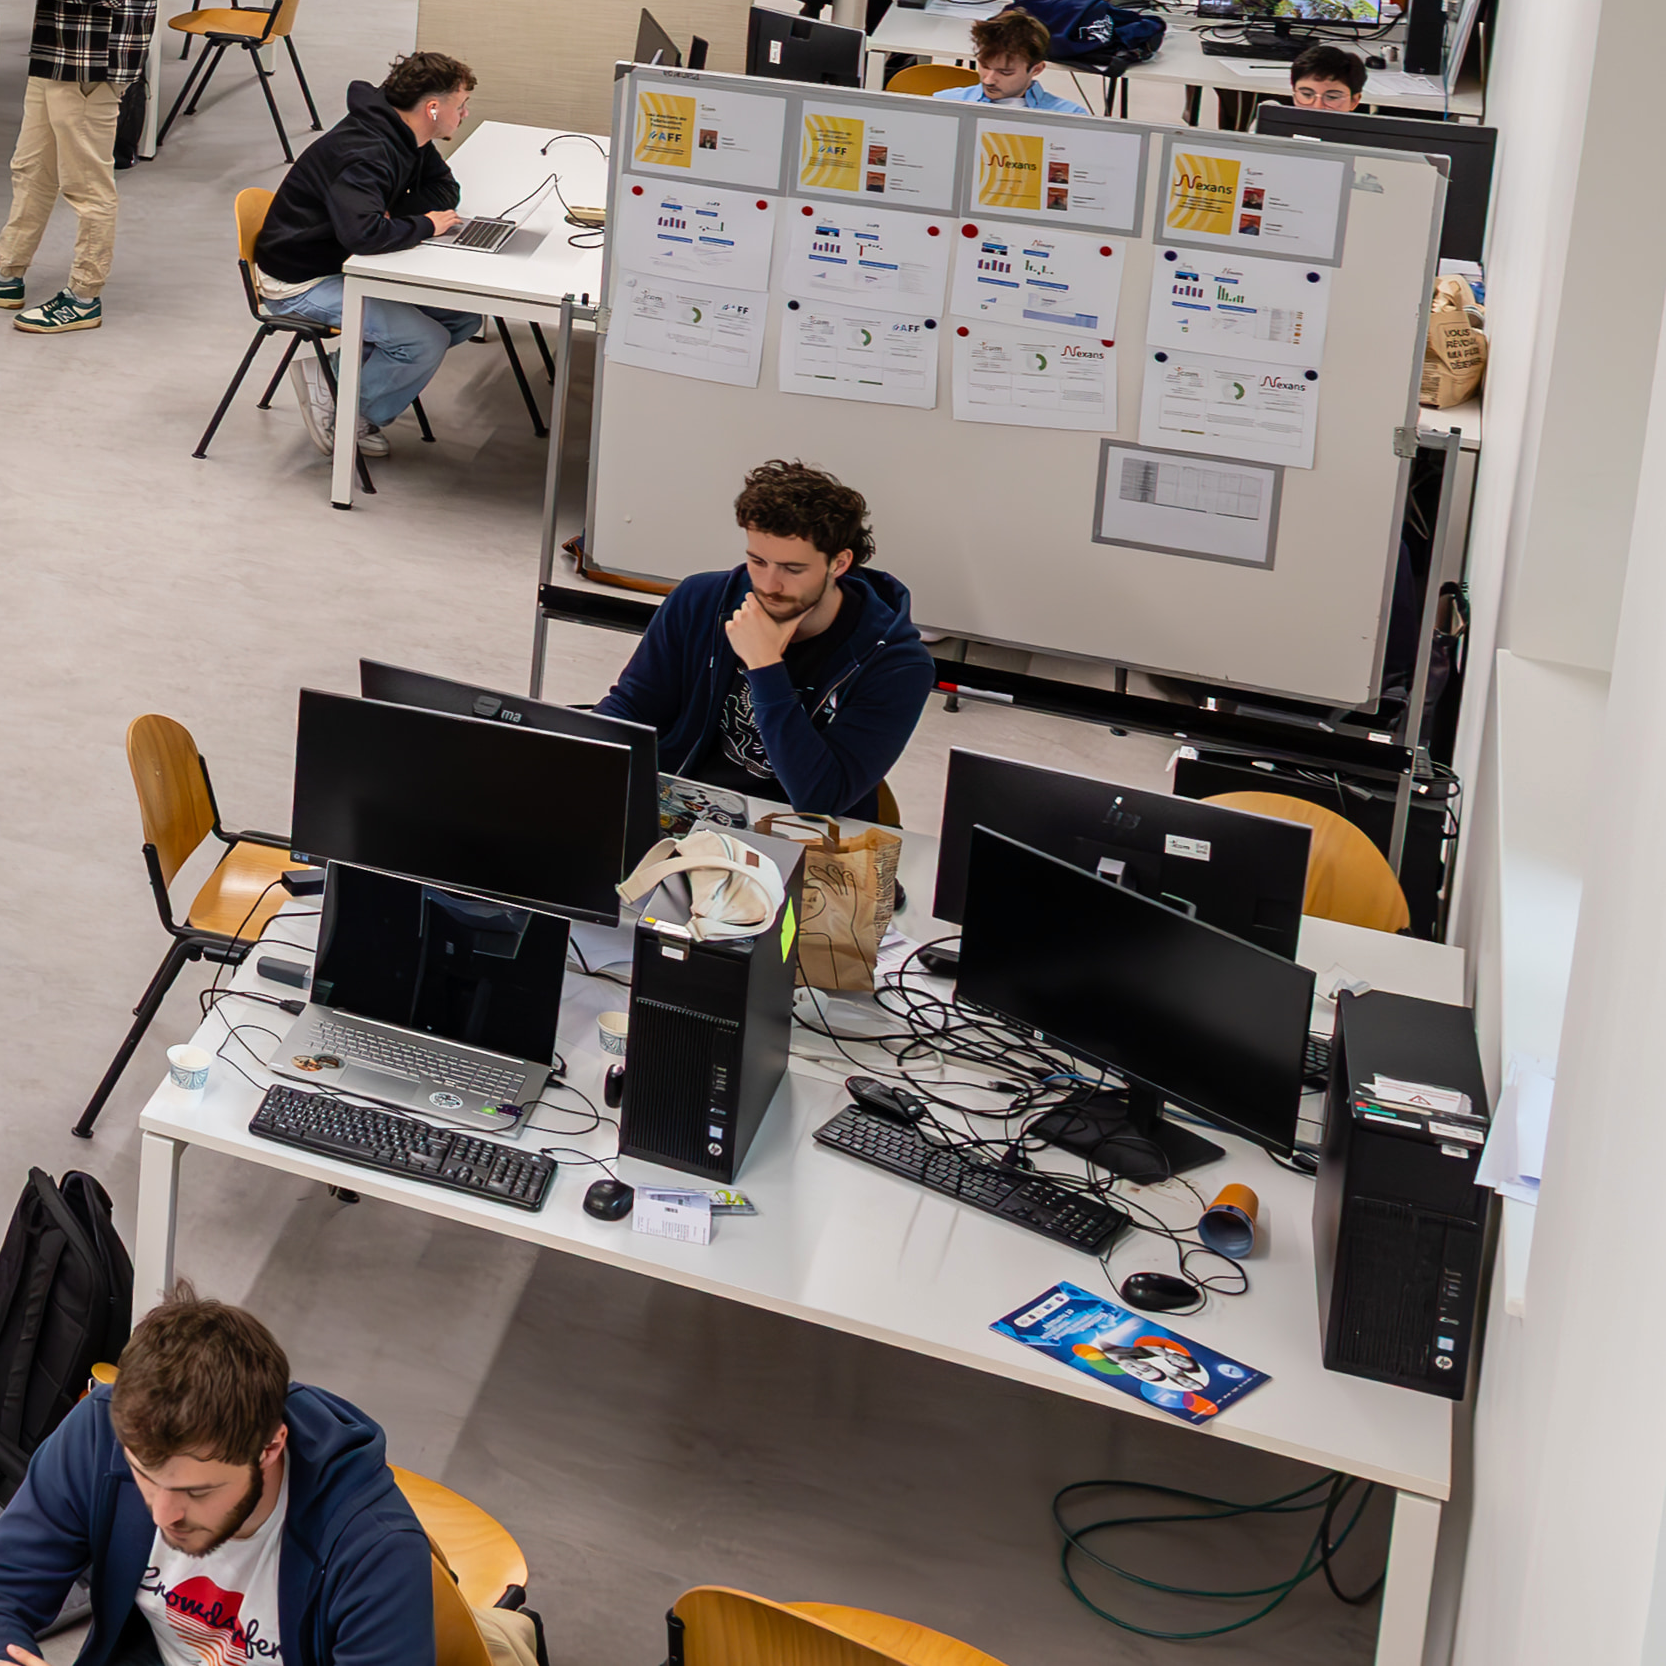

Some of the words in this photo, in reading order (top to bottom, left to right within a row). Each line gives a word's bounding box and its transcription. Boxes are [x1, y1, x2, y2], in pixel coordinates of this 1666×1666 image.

[988, 154, 1037, 171] Nexans
[1174, 174, 1234, 195] Nexans
[1061, 345, 1105, 360] Nexans
[1260, 376, 1307, 392] Nexans
